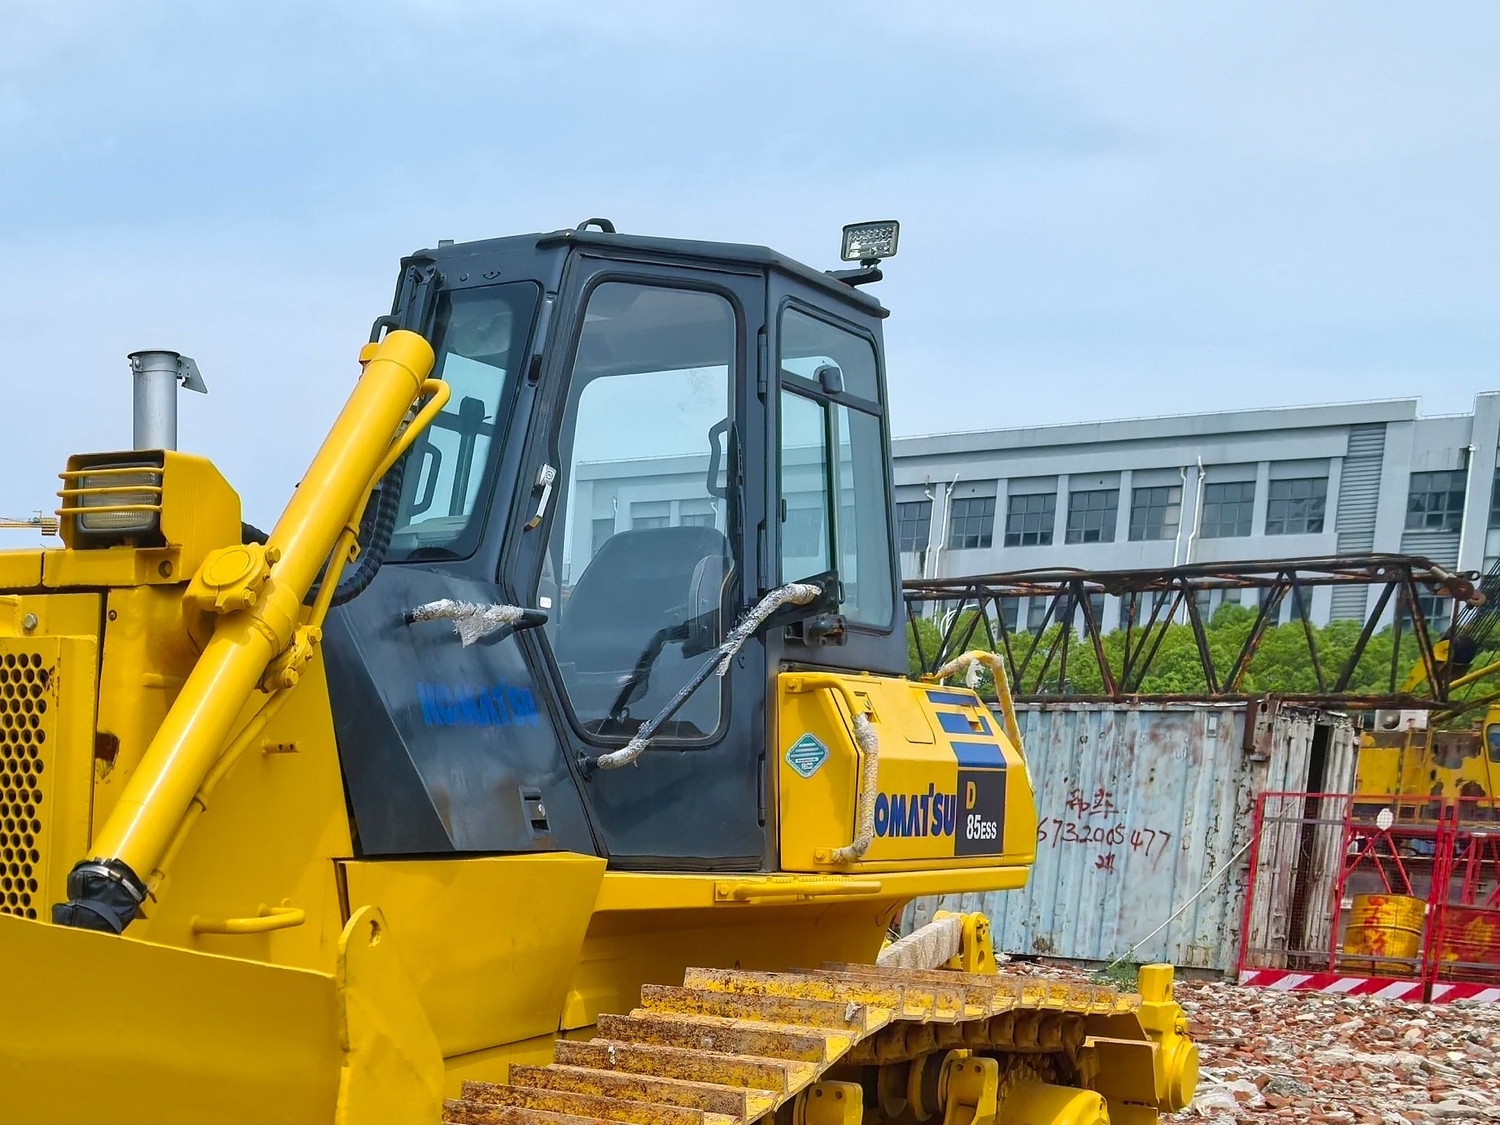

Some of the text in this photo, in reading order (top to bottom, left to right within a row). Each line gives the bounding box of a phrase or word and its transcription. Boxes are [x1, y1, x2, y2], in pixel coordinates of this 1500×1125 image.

[966, 781, 977, 809] D
[862, 783, 957, 838] OMATSU
[966, 814, 997, 840] 85ESS
